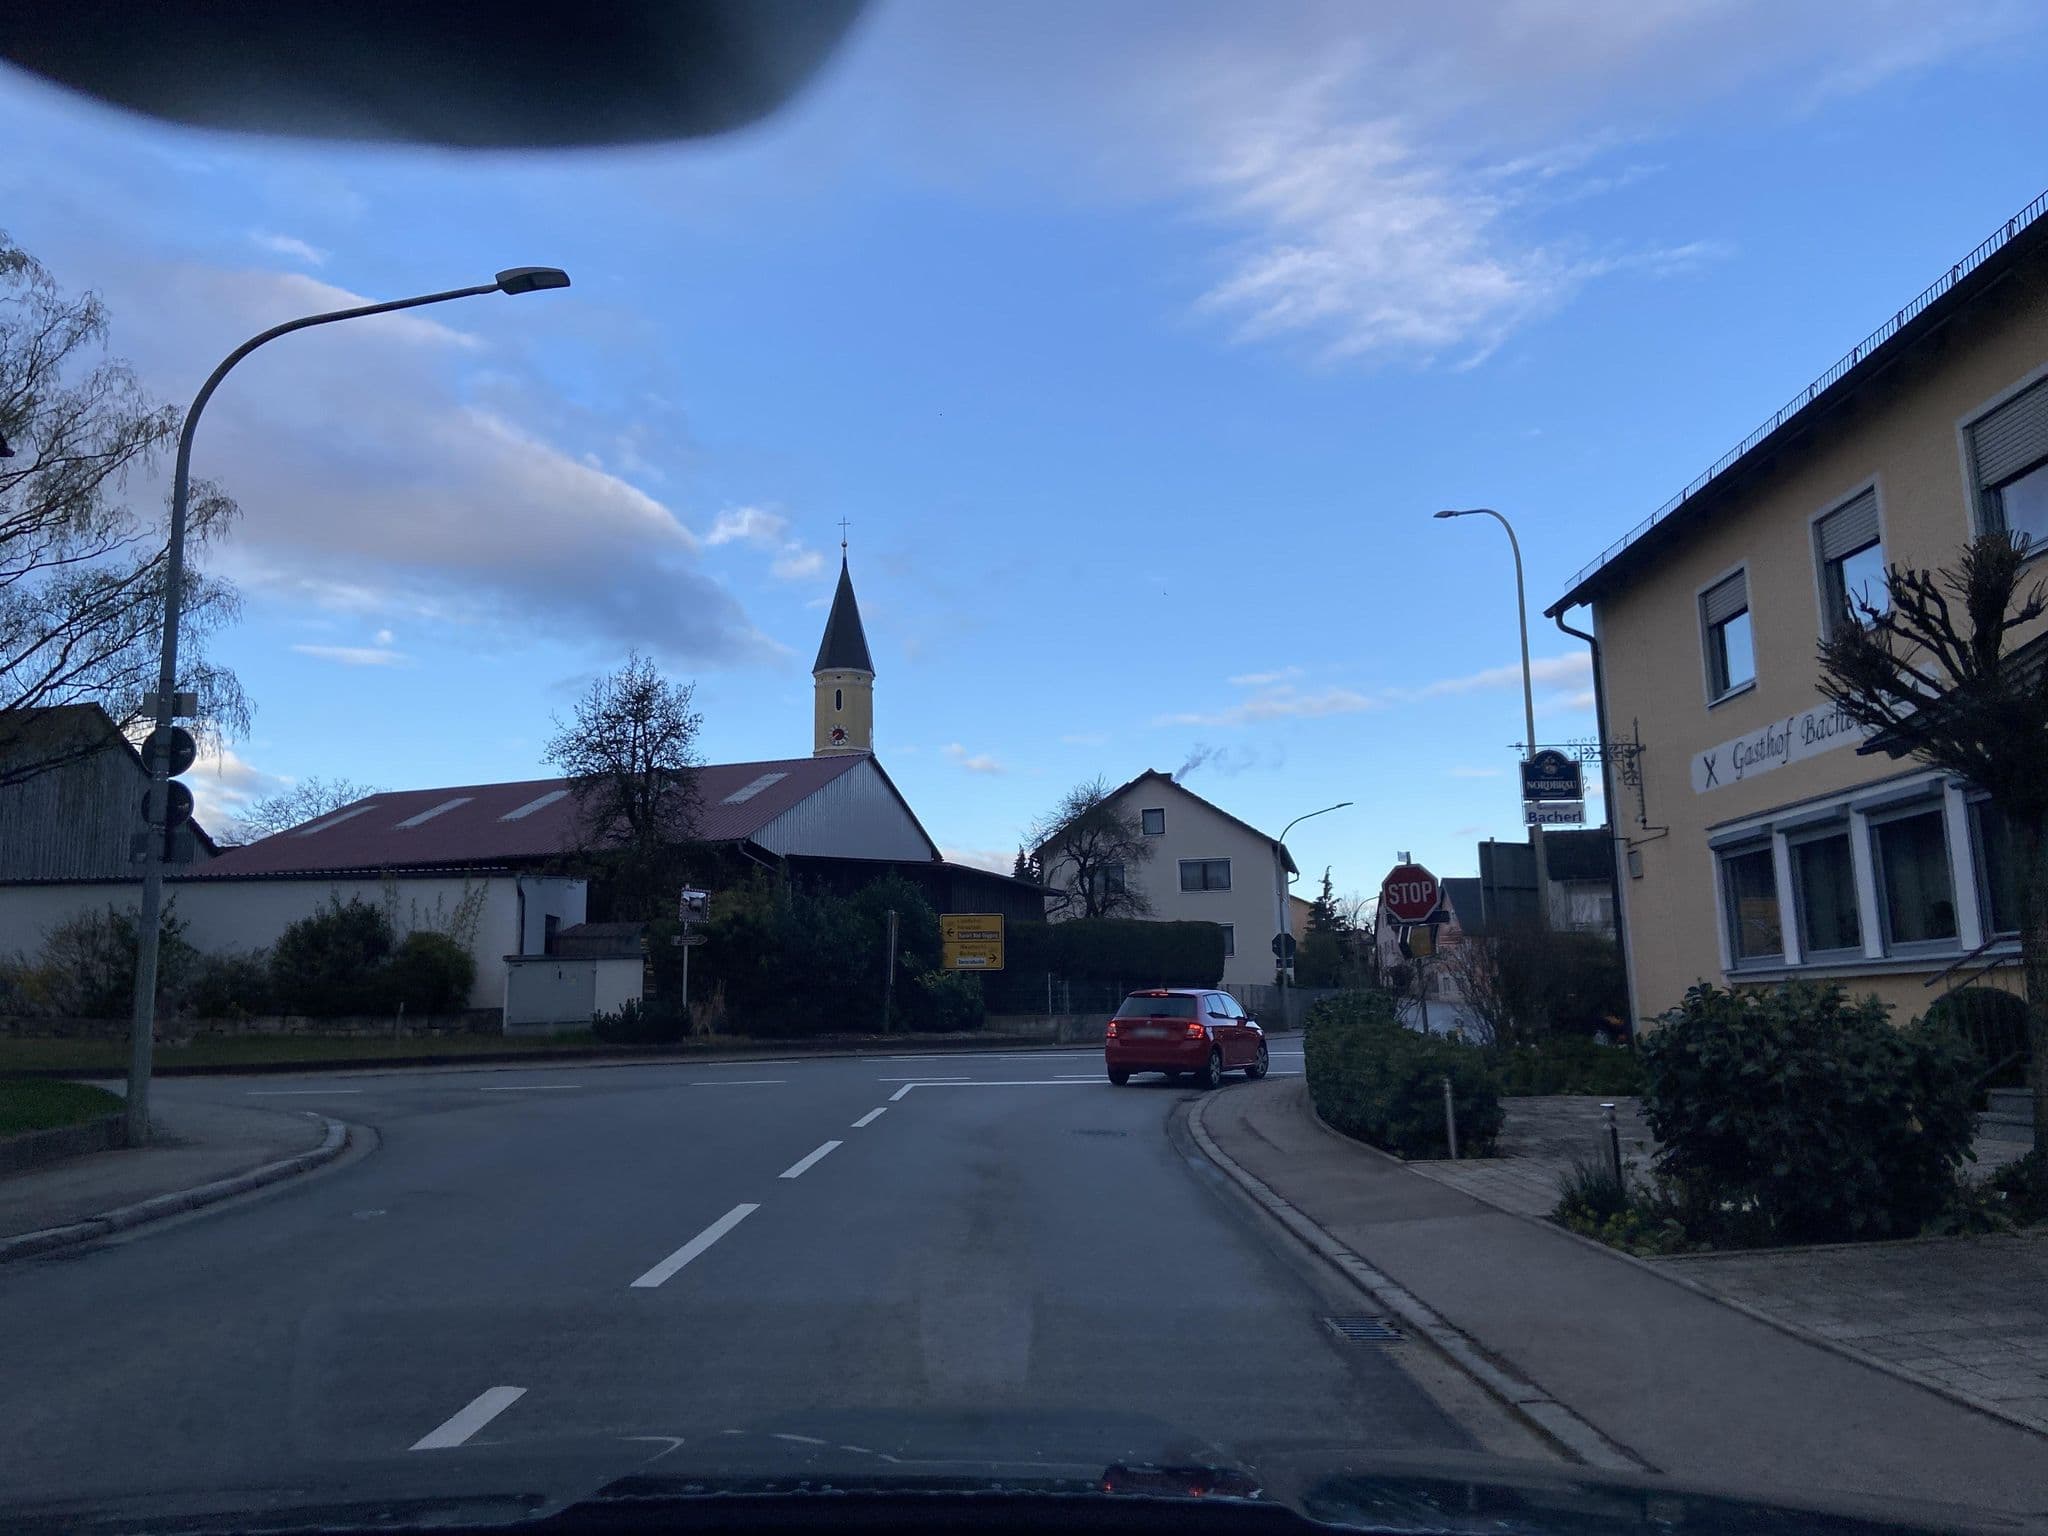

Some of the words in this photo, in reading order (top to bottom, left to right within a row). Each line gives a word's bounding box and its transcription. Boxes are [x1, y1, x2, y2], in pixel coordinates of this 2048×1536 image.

[1733, 717, 1794, 780] Gasthof
[1528, 811, 1582, 823] Bacherl
[1388, 881, 1432, 905] STOP
